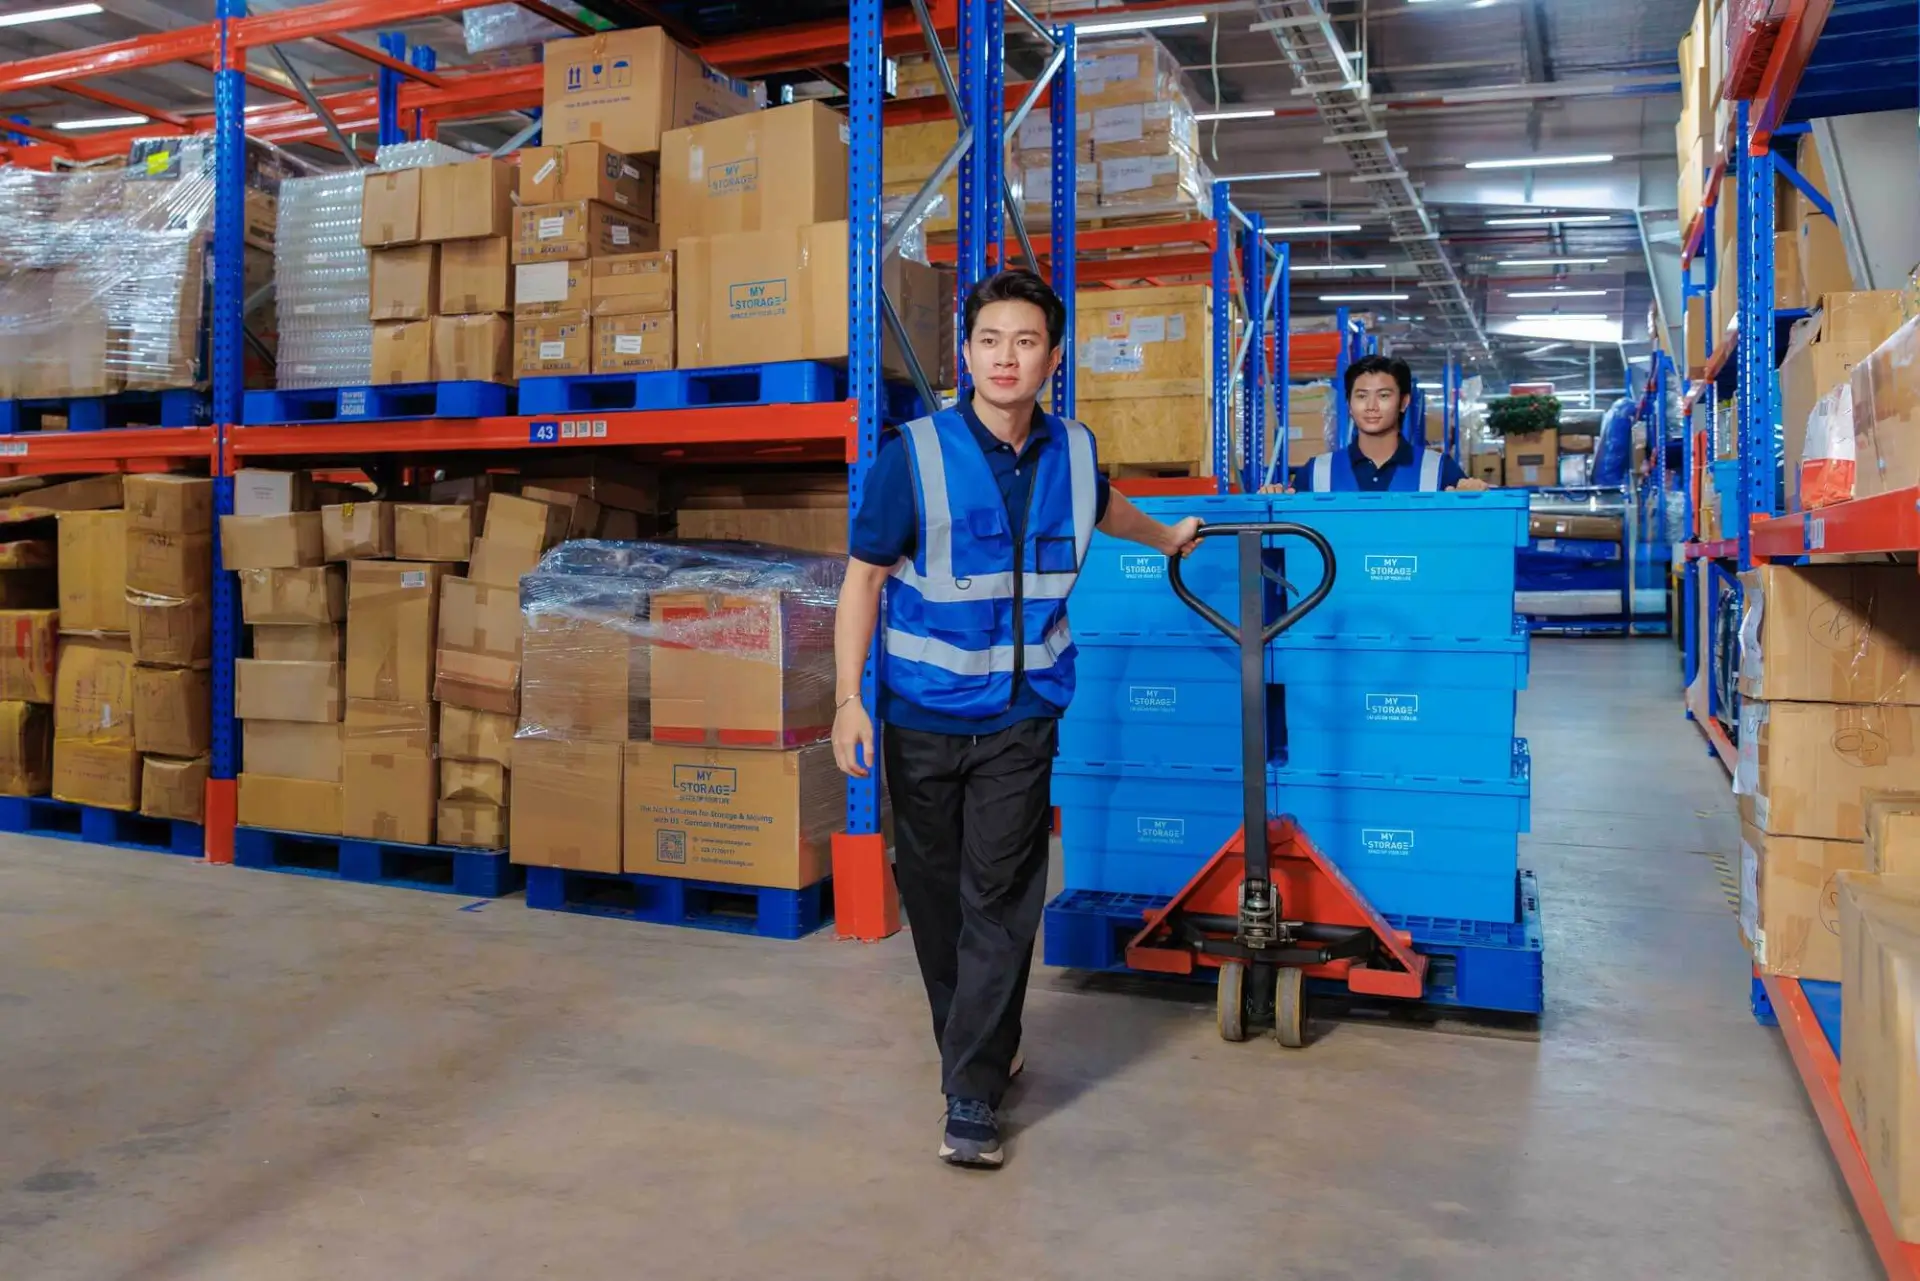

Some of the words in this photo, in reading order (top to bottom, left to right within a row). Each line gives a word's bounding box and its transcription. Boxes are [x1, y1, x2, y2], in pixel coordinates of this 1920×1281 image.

[750, 286, 765, 296] MY
[735, 297, 781, 310] STORAGE
[536, 425, 554, 440] 43
[1136, 557, 1149, 566] MY
[1384, 558, 1397, 566] MY
[1125, 566, 1163, 574] STORAGE
[1370, 566, 1412, 575] STORAGE
[1146, 690, 1159, 698] MY
[1134, 697, 1172, 706] STORAGE
[1384, 697, 1399, 705] MY
[1371, 705, 1413, 714] STORAGE
[697, 770, 712, 781] MY
[680, 782, 730, 796] STORAGE
[711, 811, 737, 820] Storage
[1154, 821, 1167, 829] MY
[1142, 828, 1180, 838] STORAGE
[1380, 832, 1394, 841] MY
[1367, 840, 1409, 850] STORAGE
